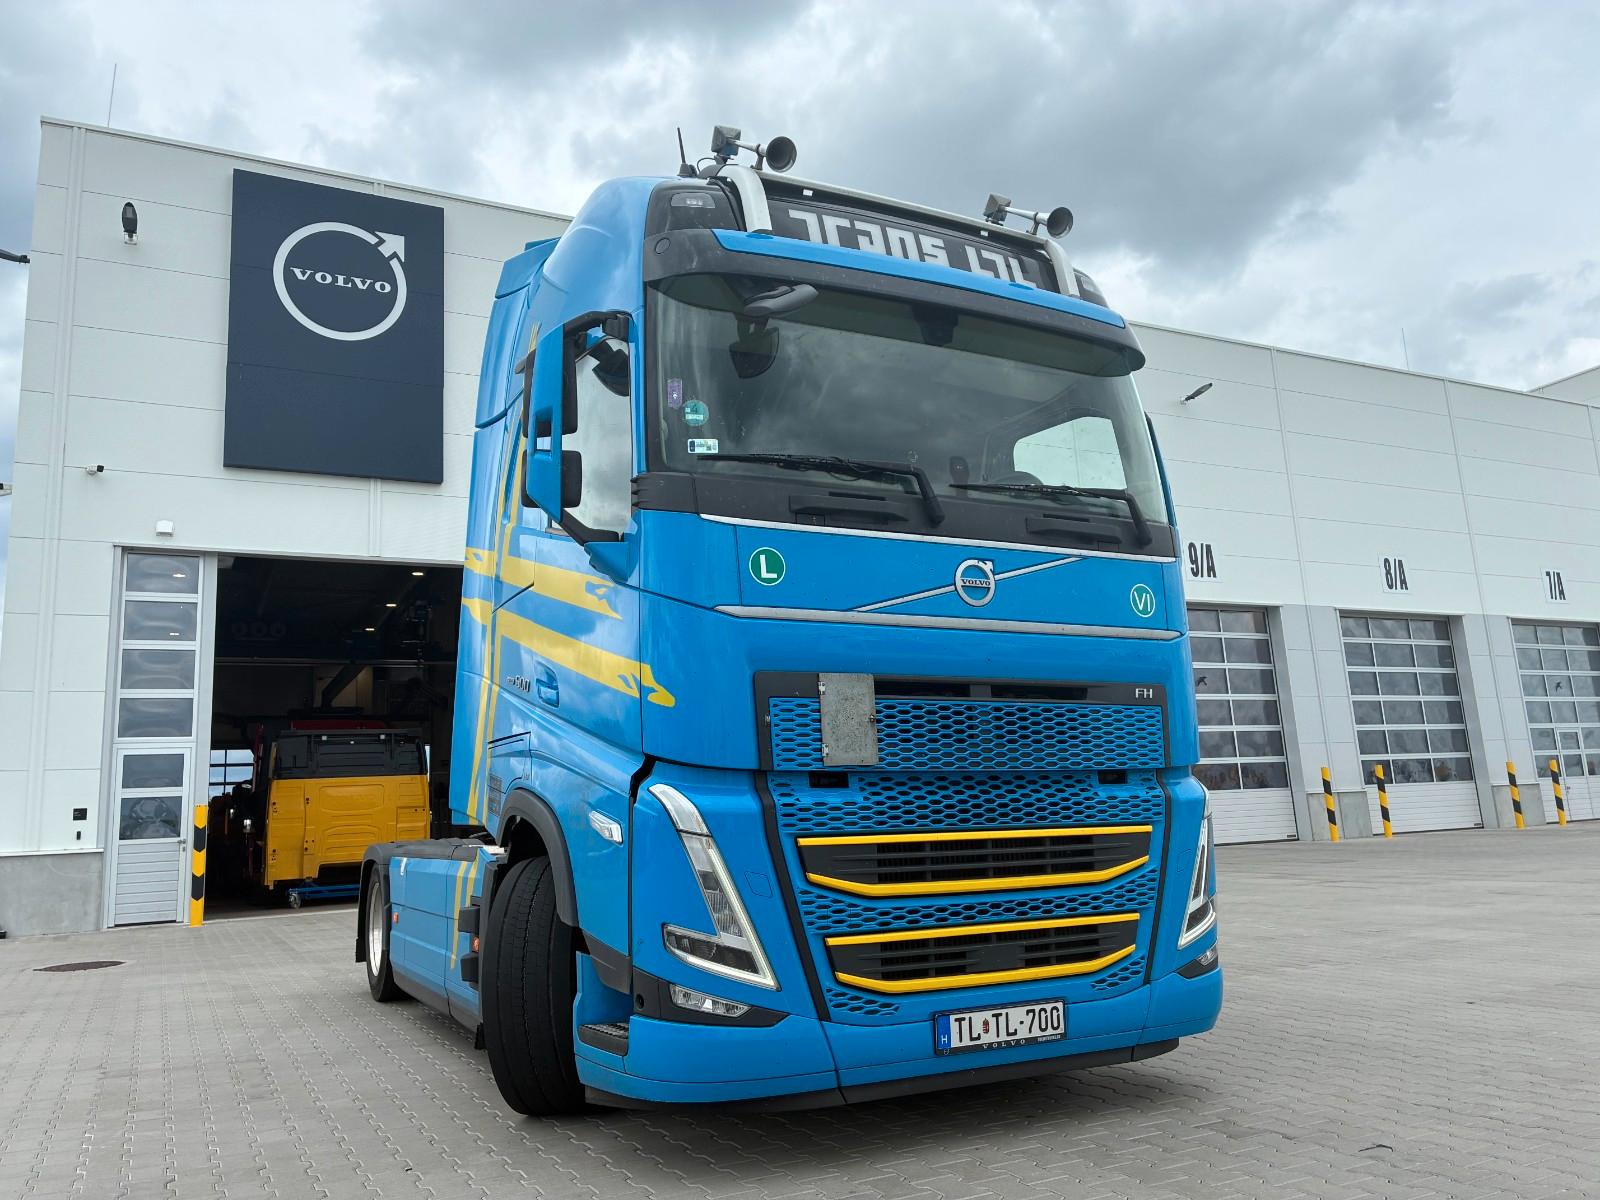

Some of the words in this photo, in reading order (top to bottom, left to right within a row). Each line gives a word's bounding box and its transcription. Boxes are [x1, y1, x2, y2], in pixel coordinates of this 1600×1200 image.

[290, 267, 392, 293] VOLVO
[760, 554, 778, 579] L
[1188, 542, 1217, 578] 9/A
[961, 578, 991, 587] VOLVO
[1383, 557, 1409, 591] 8/A
[1545, 571, 1567, 601] 7/A
[1134, 590, 1151, 612] VI
[1135, 688, 1153, 699] FH
[954, 1016, 981, 1043] TL
[991, 1005, 1061, 1038] TL-700
[941, 1035, 948, 1044] H
[982, 1039, 1025, 1049] VOLVO
